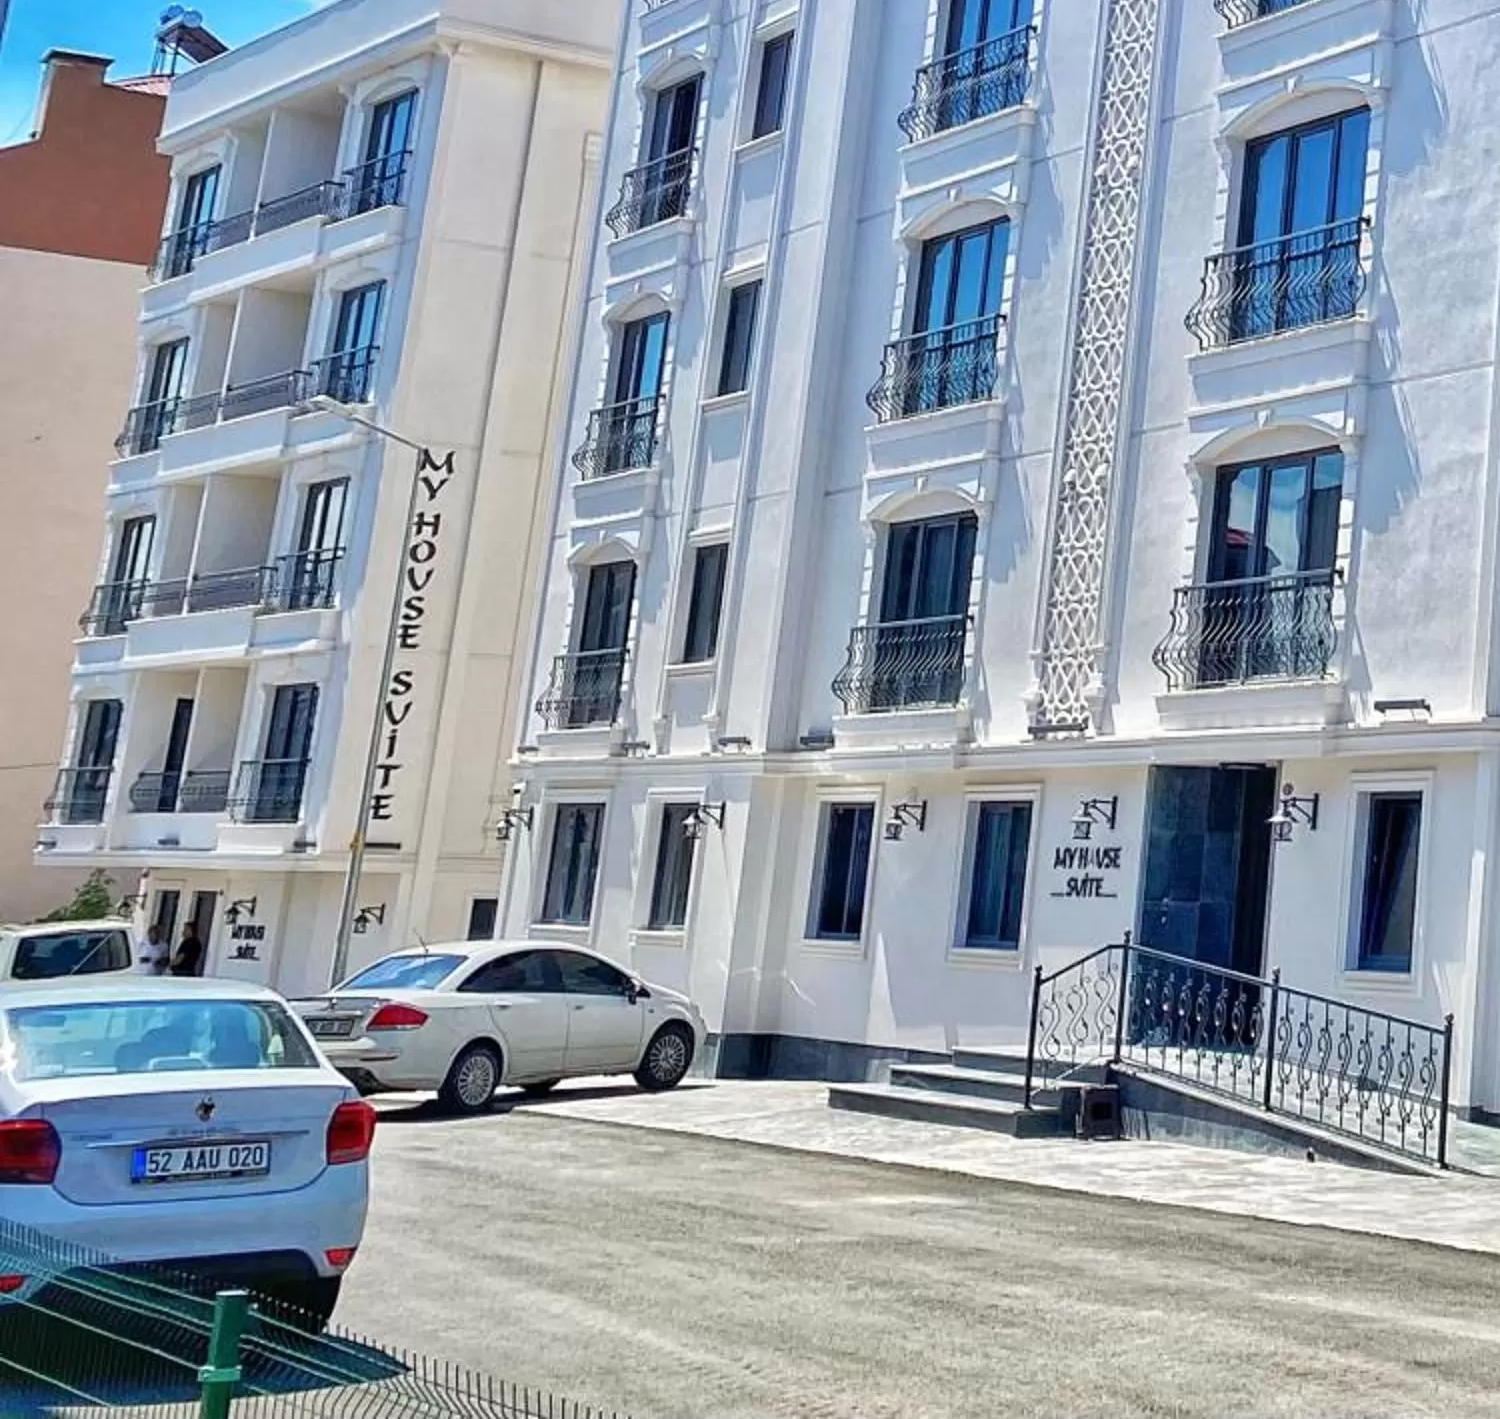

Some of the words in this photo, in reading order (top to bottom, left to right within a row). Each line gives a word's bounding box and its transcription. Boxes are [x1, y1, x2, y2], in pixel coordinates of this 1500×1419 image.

[419, 449, 455, 502] MY
[1053, 847, 1078, 869] MY
[148, 1152, 173, 1173] 52
[182, 1149, 220, 1172] AAU
[229, 1146, 264, 1169] 020
